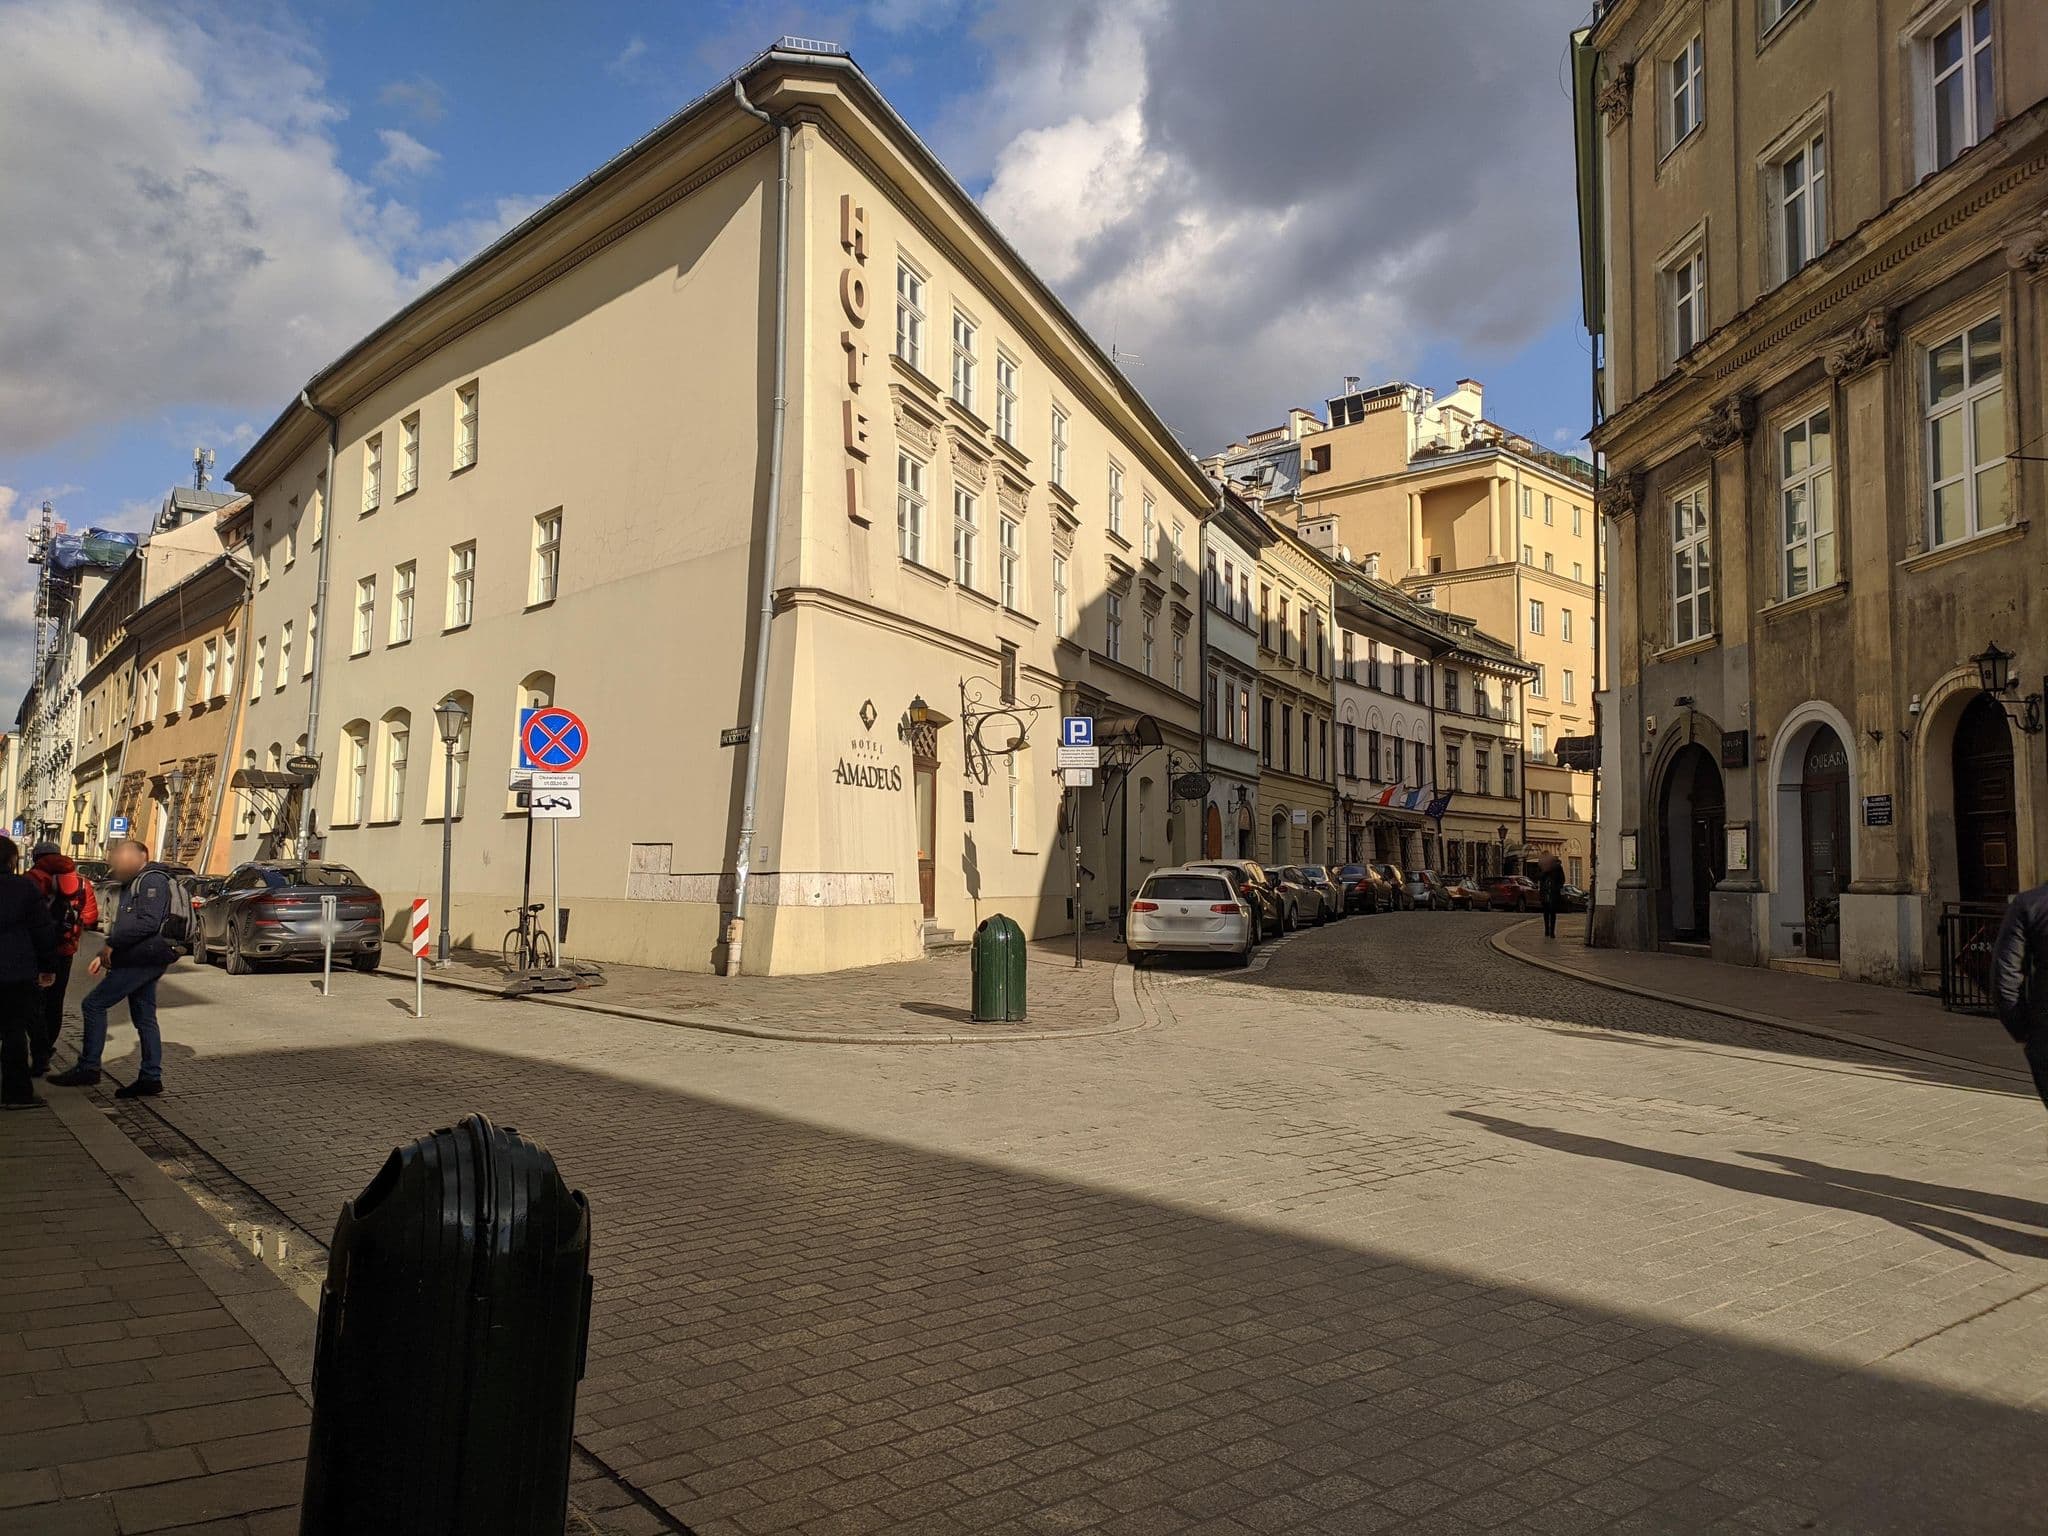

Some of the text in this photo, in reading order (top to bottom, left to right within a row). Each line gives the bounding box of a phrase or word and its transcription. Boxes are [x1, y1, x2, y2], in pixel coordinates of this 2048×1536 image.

[840, 193, 873, 530] HOTEL
[1984, 669, 1992, 680] 9
[1070, 720, 1087, 743] P
[851, 739, 885, 755] HOTEL
[832, 756, 902, 791] AMADEUS
[114, 818, 124, 829] P
